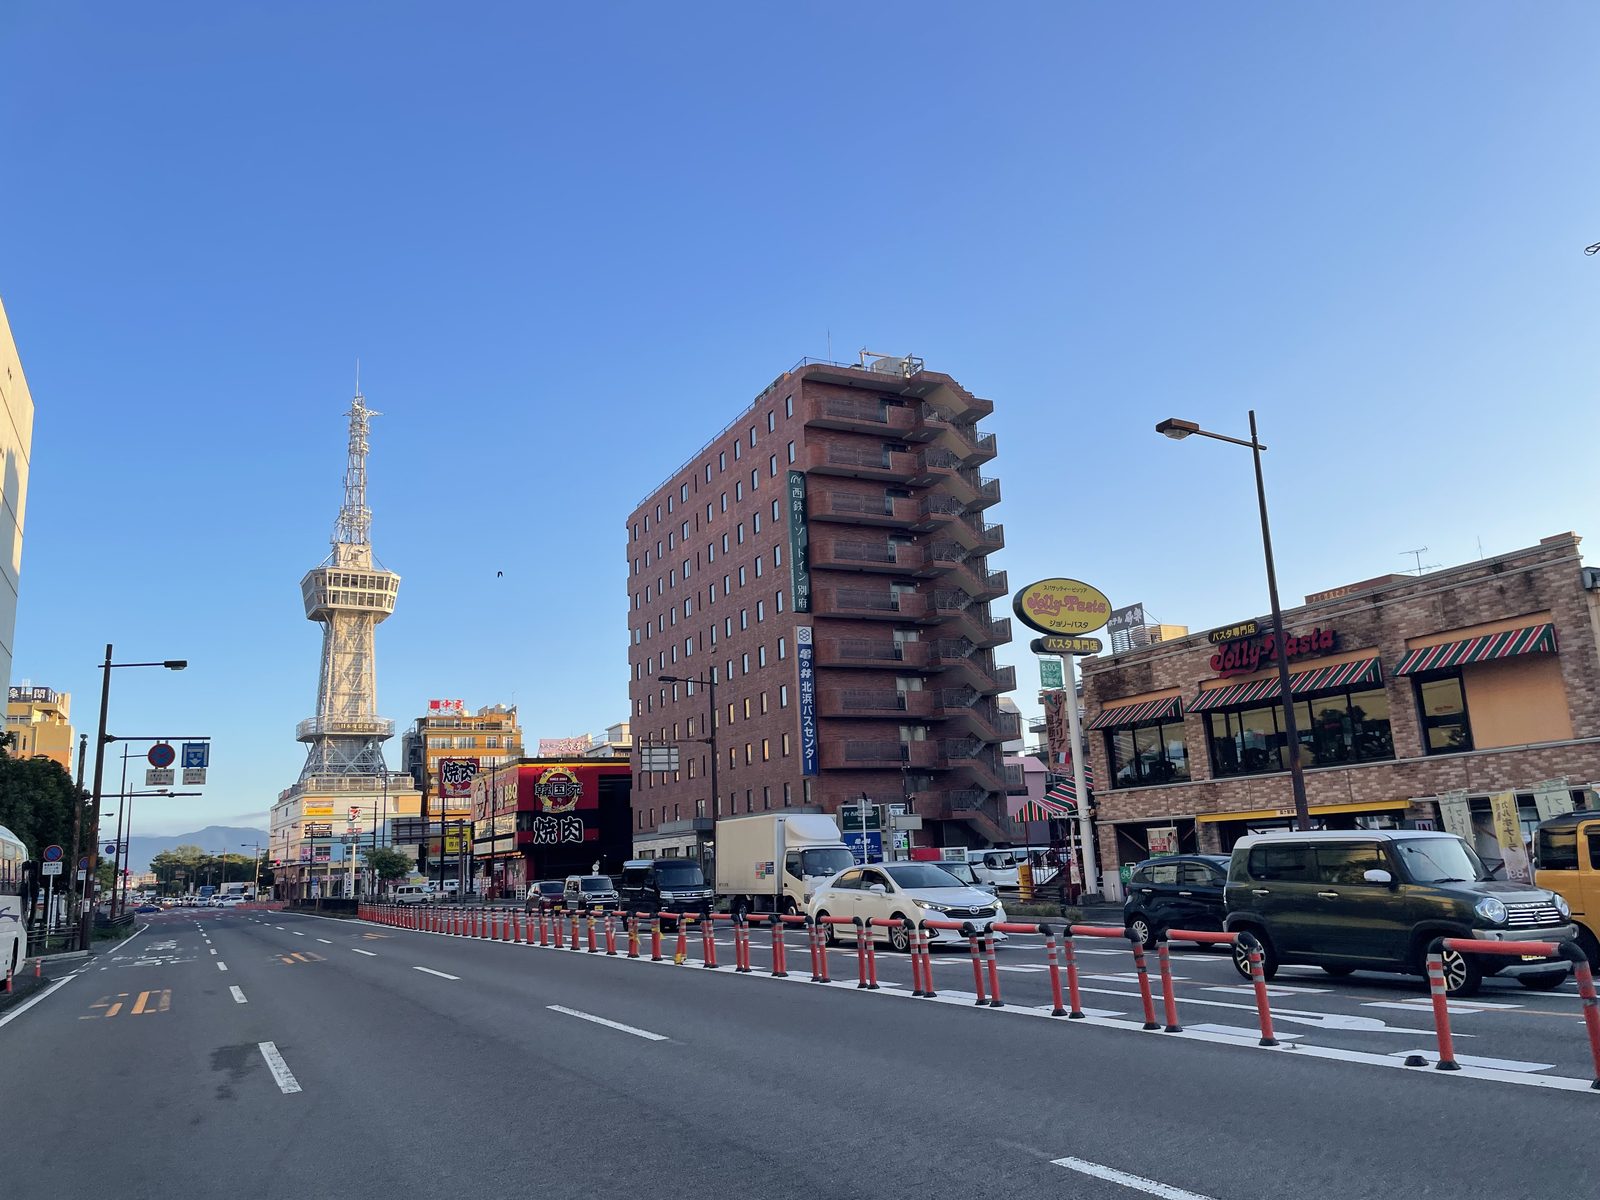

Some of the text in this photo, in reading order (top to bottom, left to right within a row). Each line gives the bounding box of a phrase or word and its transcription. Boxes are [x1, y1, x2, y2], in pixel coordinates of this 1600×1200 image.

[793, 488, 807, 608] 西鉄リゾートイン別府
[1049, 620, 1088, 628] ジョリーパスタ
[1212, 623, 1255, 642] パスタ専門店
[1048, 638, 1098, 651] パスタ専門店
[801, 681, 814, 770] 北浜バスセンター
[442, 761, 478, 783] 焼肉
[505, 782, 517, 801] BBQ
[535, 782, 584, 797] 韓国苑
[533, 816, 583, 844] 焼肉
